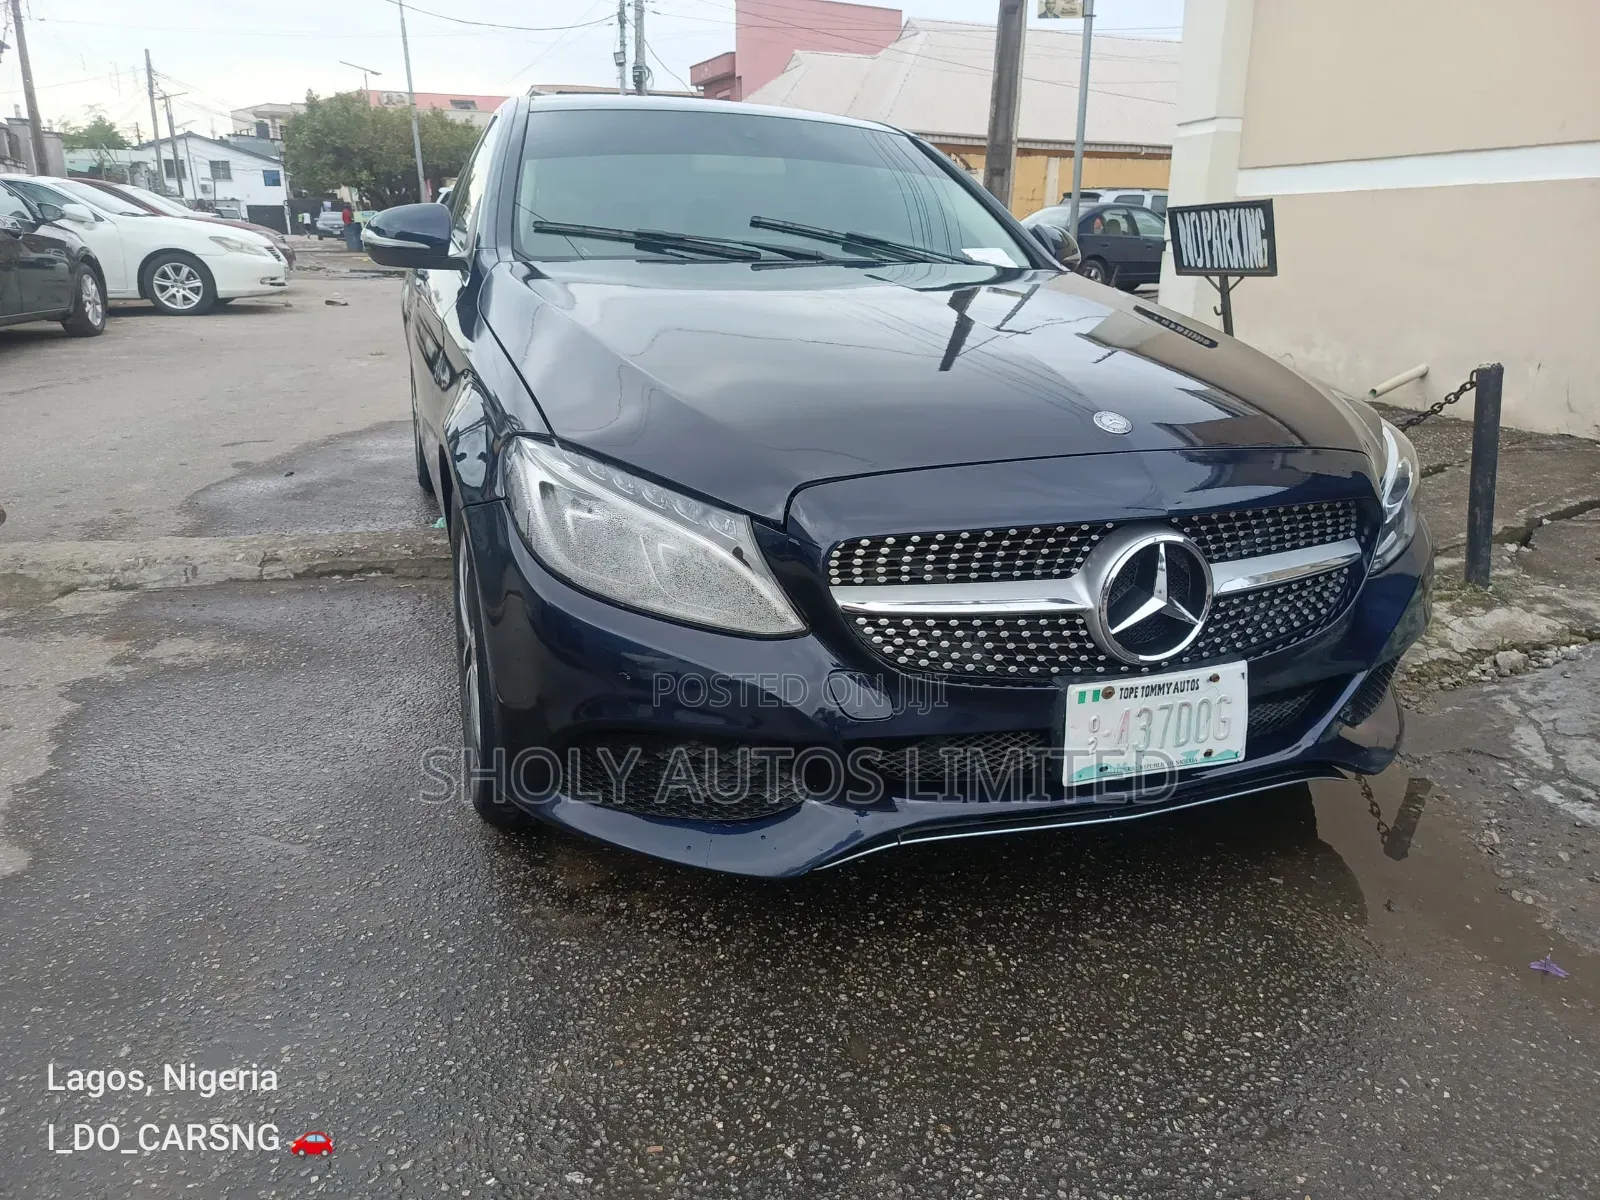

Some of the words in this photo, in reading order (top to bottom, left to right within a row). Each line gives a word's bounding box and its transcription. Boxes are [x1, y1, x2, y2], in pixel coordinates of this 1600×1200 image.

[1119, 687, 1139, 700] TOPE
[1140, 683, 1174, 697] TOMMY
[1173, 678, 1200, 694] AUTOS
